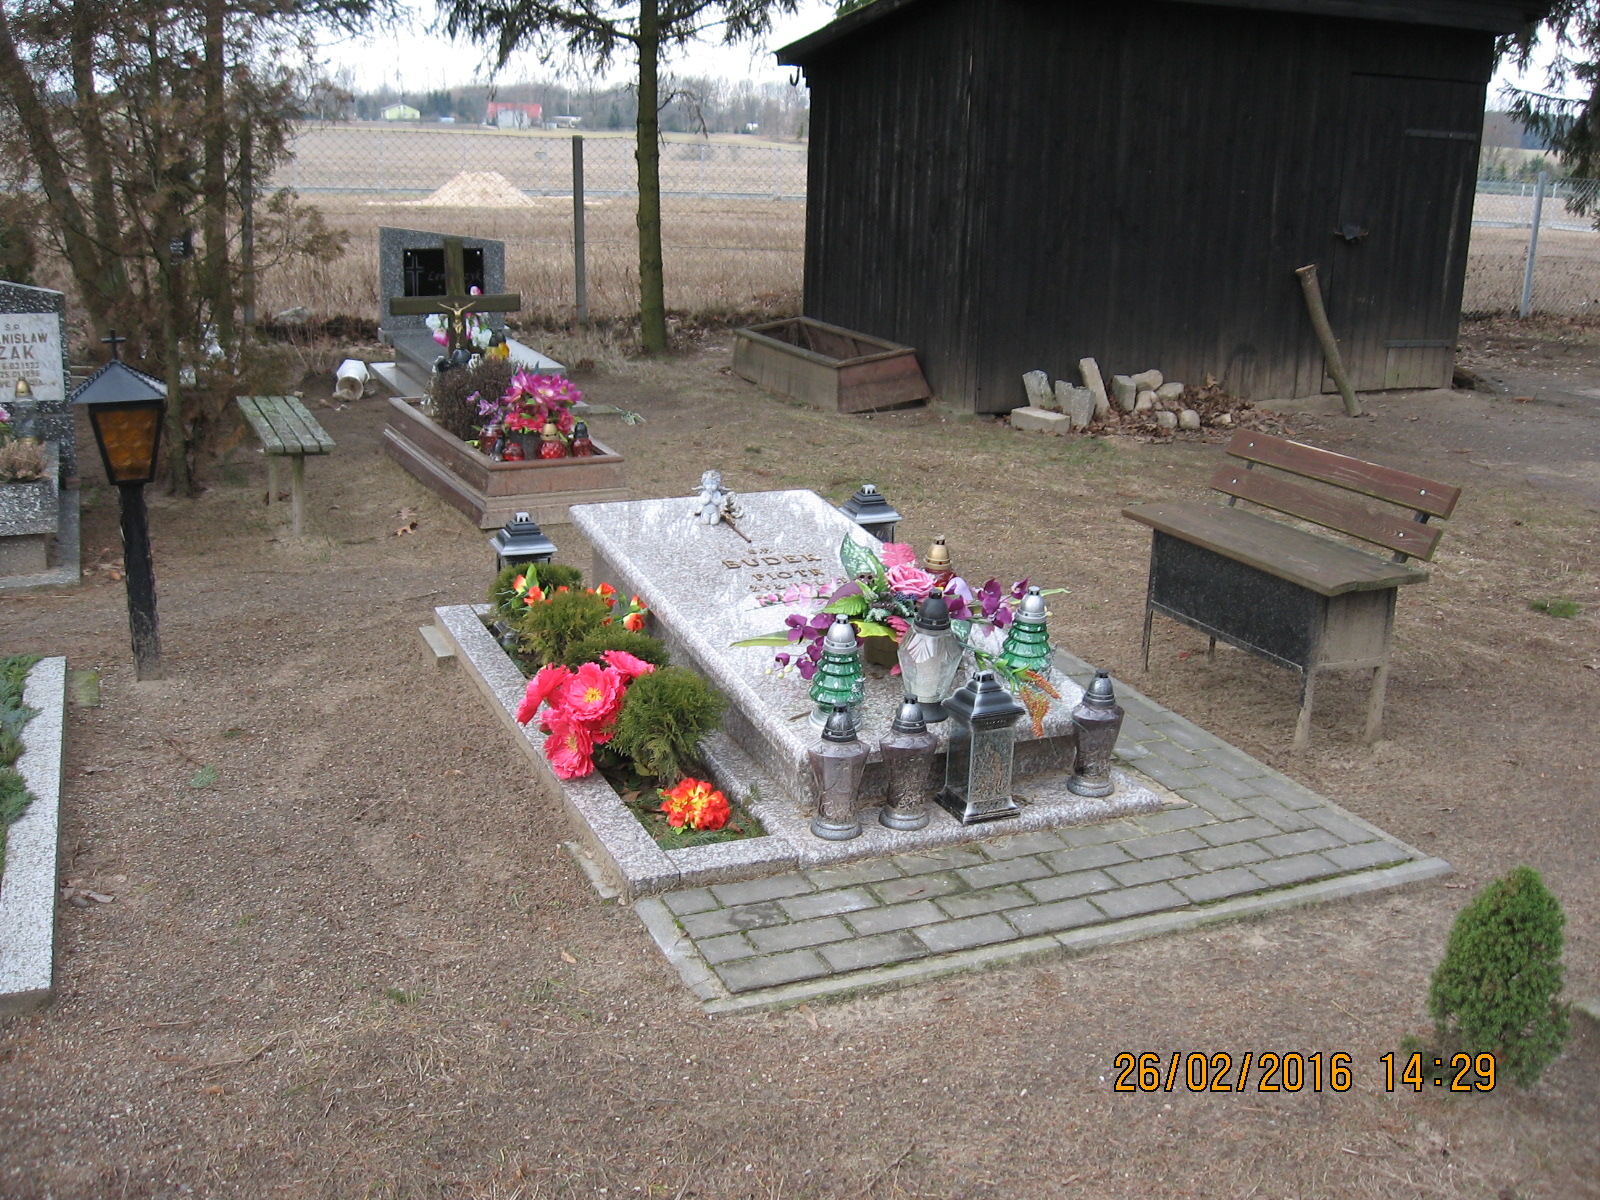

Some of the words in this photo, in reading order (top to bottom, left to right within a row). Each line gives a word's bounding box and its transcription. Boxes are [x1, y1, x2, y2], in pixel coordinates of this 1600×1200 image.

[0, 333, 47, 344] NISŁAW
[722, 553, 822, 569] BUDEK
[752, 568, 825, 581] PIOTR
